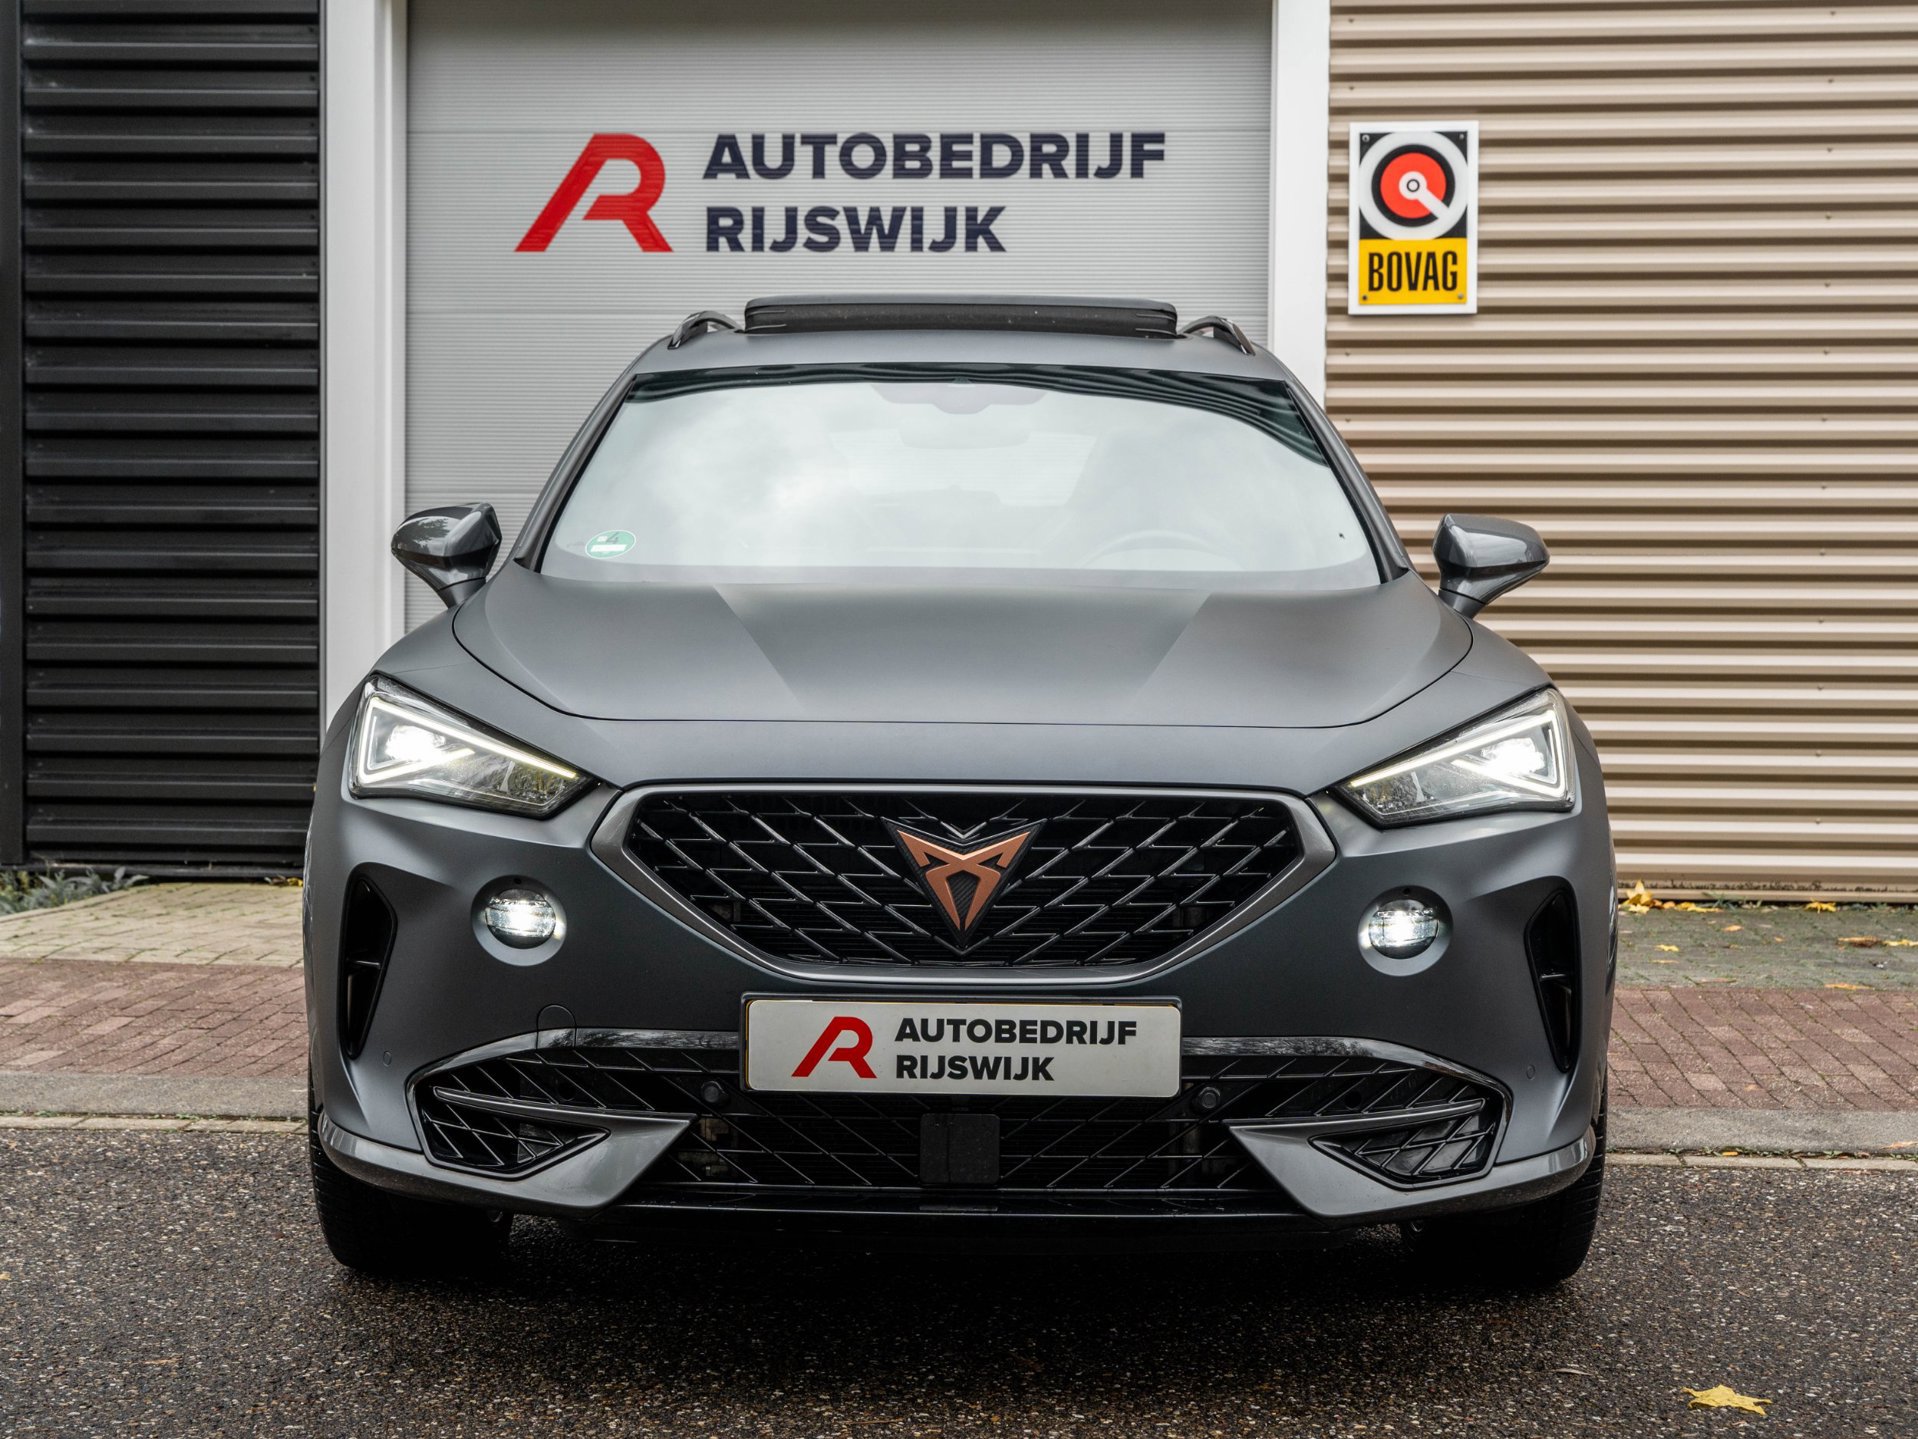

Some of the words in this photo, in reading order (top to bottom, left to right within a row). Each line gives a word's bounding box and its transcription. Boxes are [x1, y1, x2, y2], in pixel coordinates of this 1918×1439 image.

[703, 132, 1166, 180] AUTOBEDRIJF
[705, 205, 1007, 253] RIJSWIJK
[1368, 250, 1458, 292] BOVAG
[895, 1017, 1137, 1046] AUTOBEDRIJF
[895, 1054, 1055, 1081] RIJSWIJK
